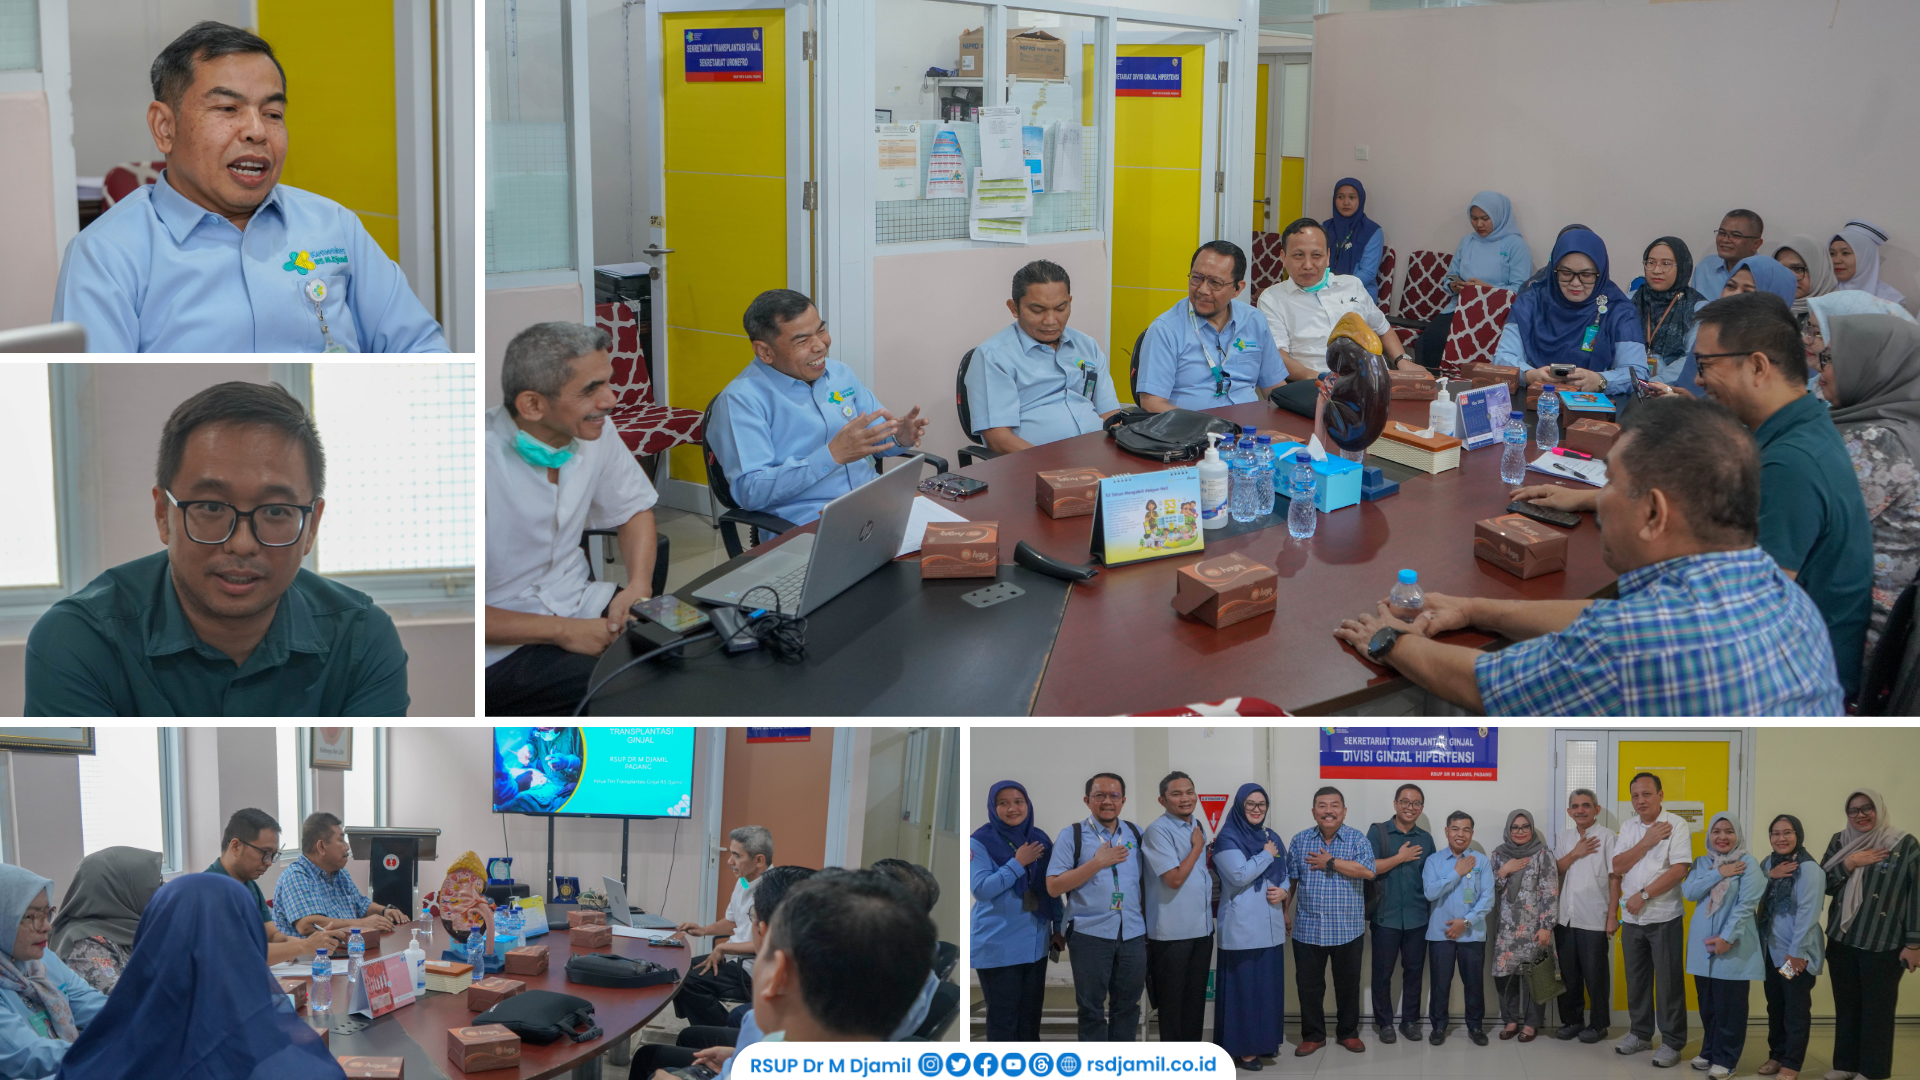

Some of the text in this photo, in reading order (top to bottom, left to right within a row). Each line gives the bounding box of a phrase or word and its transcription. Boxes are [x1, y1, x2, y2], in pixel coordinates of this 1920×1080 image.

[686, 43, 761, 53] SEKRETARIAT TRANSPLANTASI GINJAL
[1164, 498, 1176, 509] 53
[609, 727, 674, 735] TRANSPLANTASI
[1343, 736, 1474, 747] SEKRETARIAT TRANSPLANTASI GINJAL
[1343, 750, 1475, 763] DIVISI GINJAL HIPERTENSI
